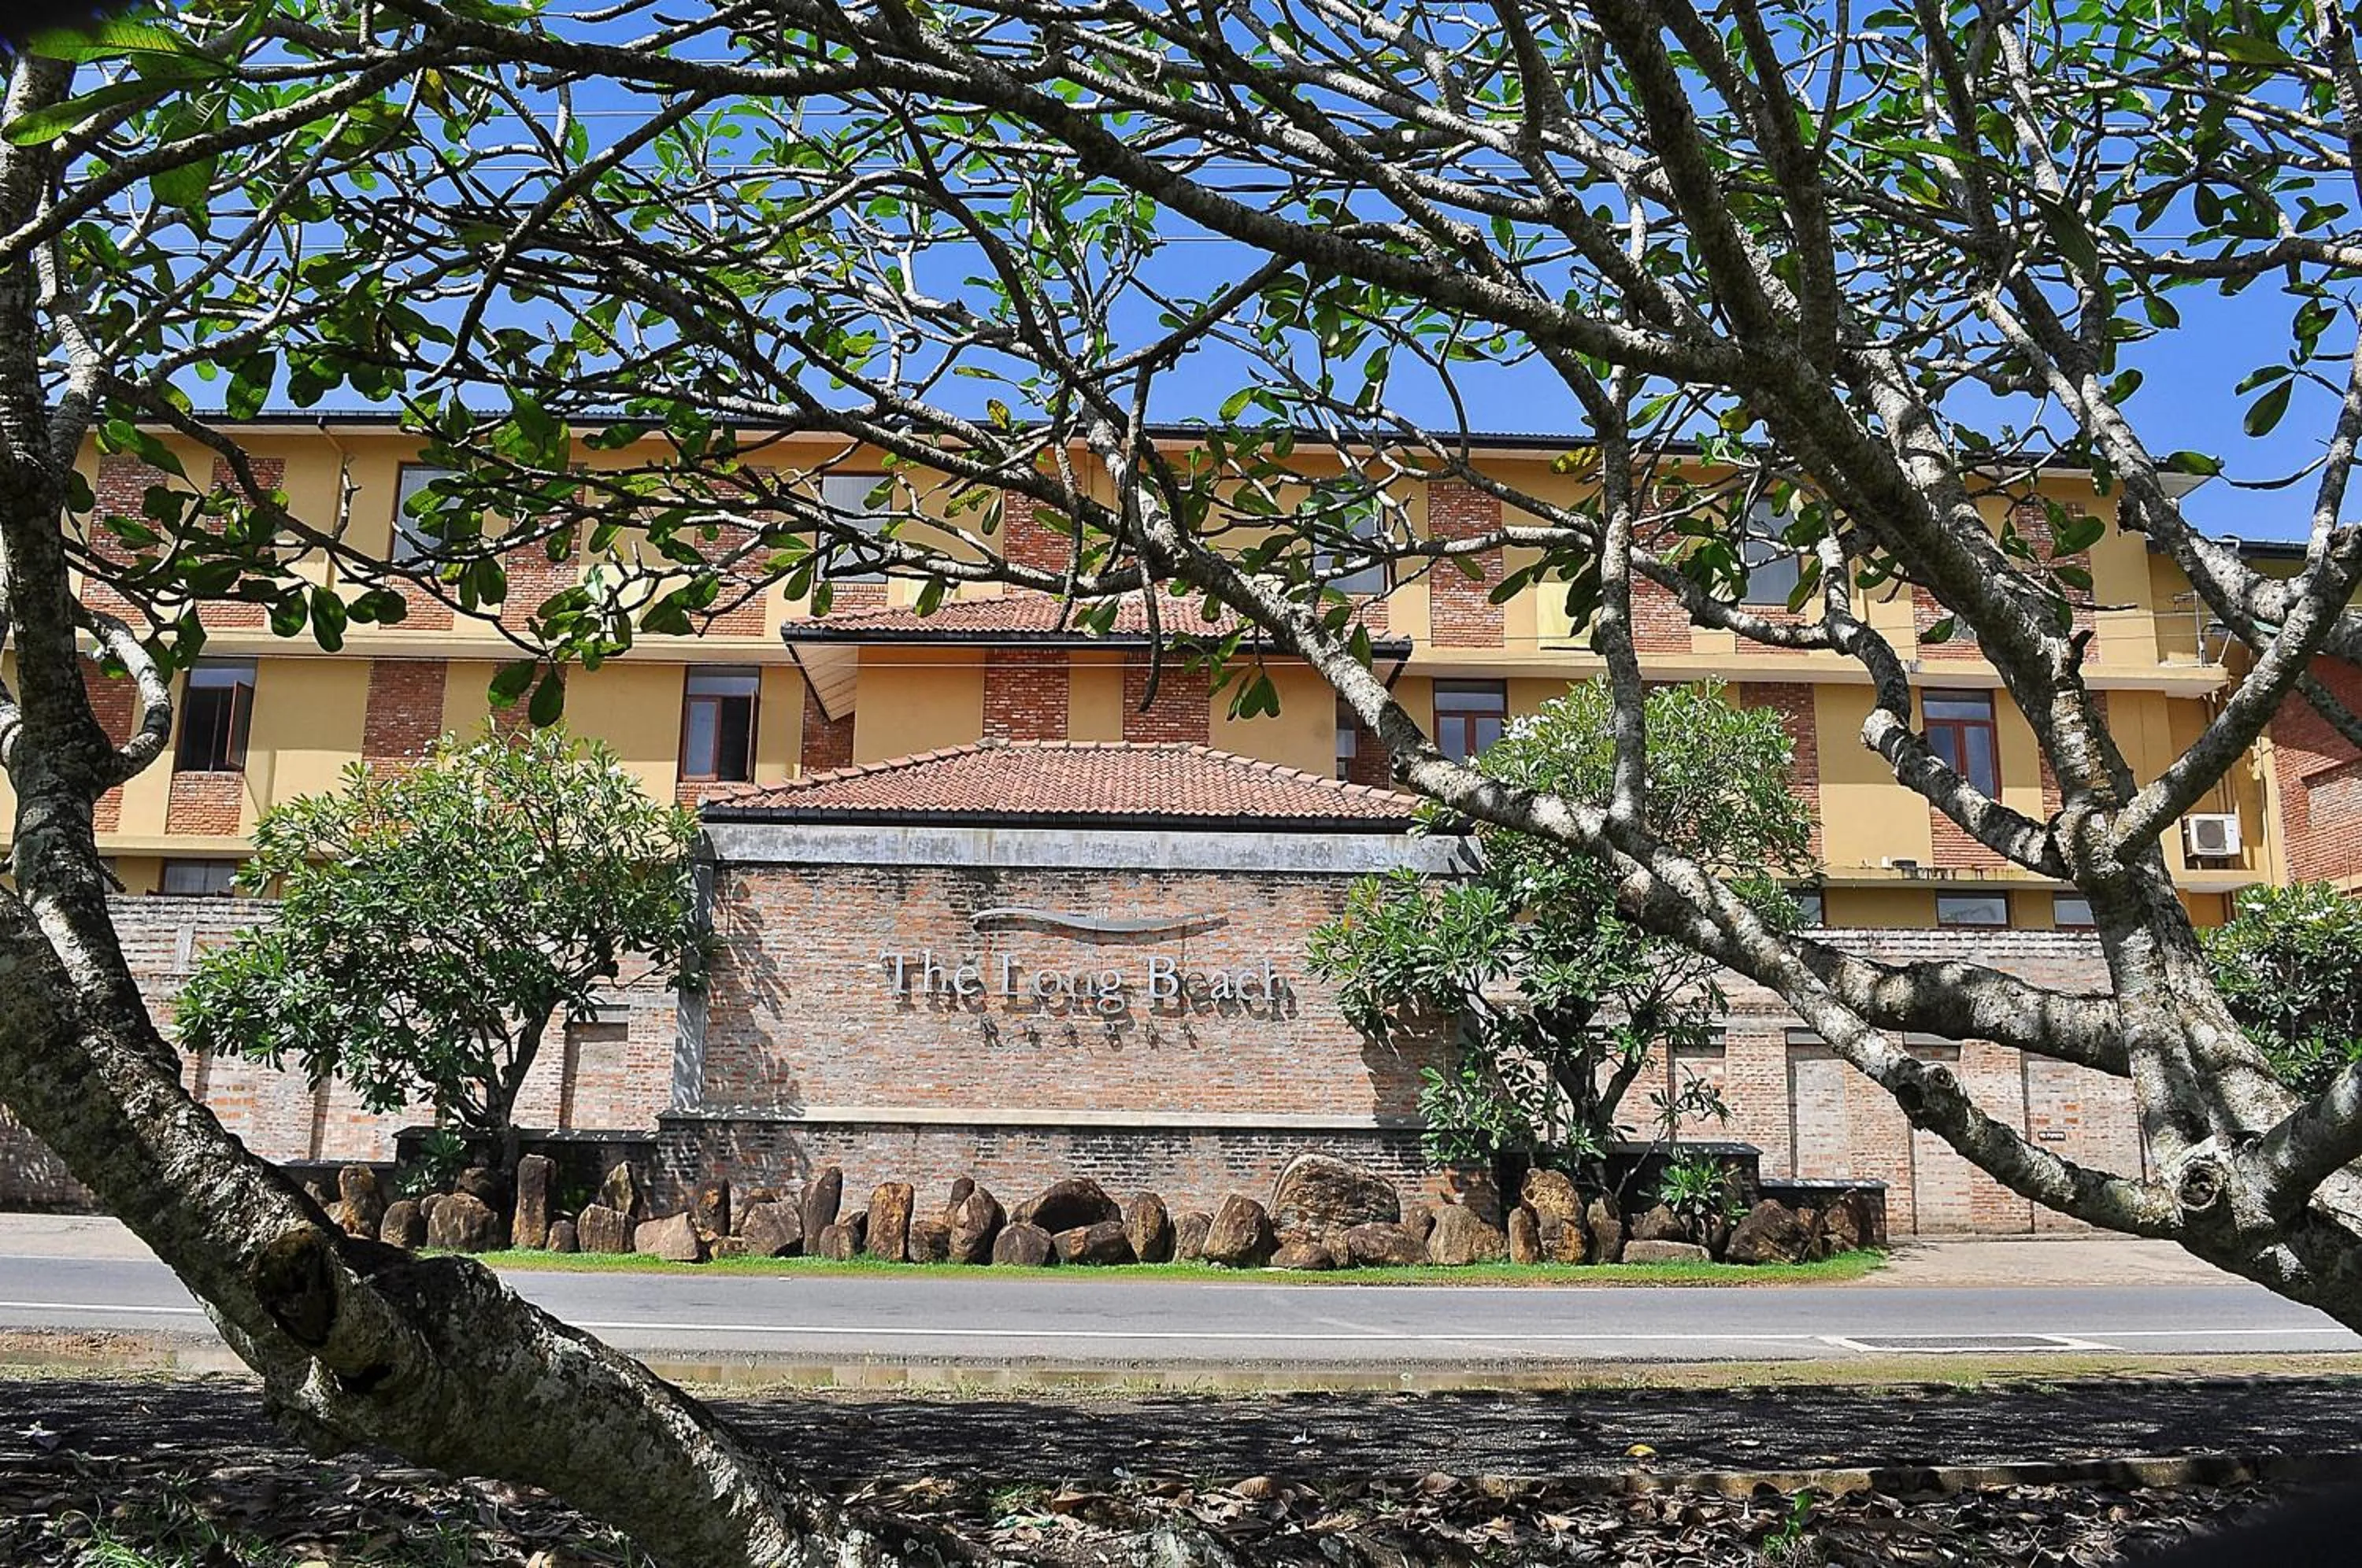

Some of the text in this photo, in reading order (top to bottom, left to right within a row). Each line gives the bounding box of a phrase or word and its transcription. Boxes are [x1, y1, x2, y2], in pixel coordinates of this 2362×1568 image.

[879, 949, 1291, 1014] The Long Beach
